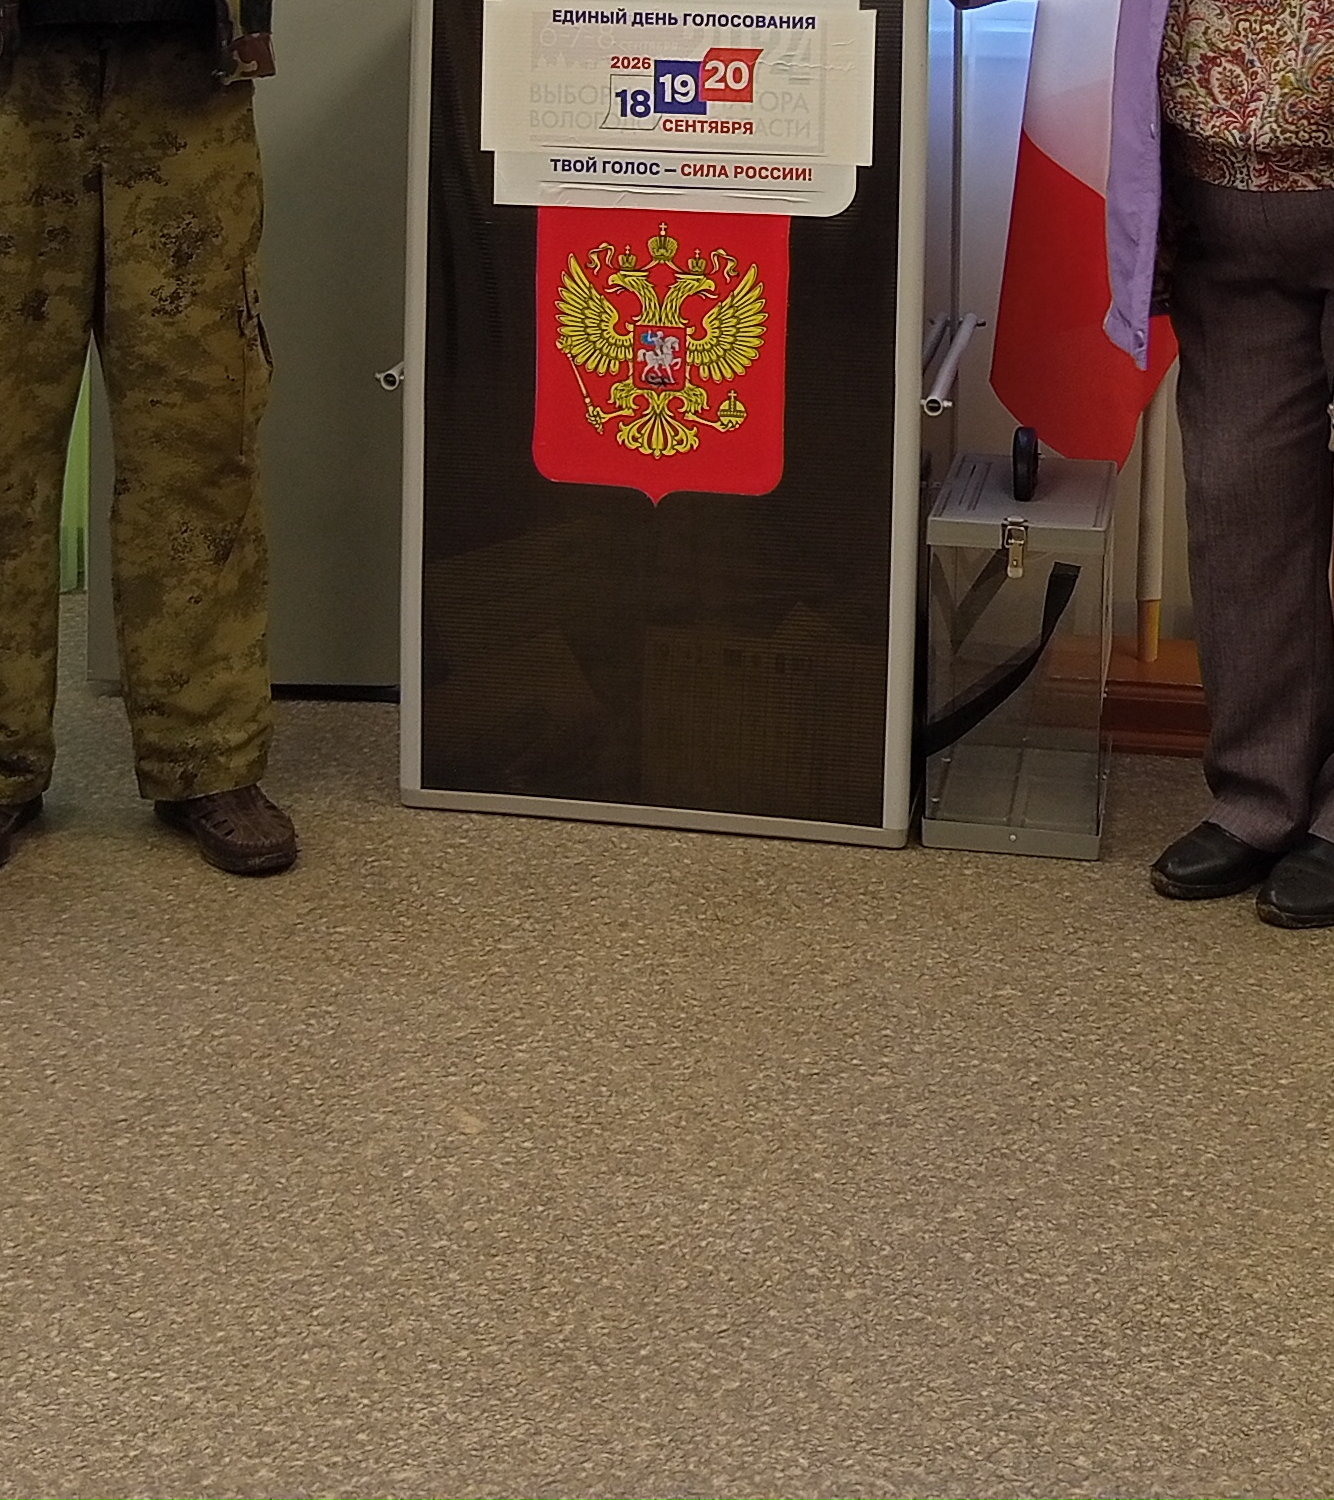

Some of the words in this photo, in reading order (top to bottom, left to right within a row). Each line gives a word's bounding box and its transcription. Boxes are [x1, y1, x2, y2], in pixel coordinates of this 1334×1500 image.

[552, 8, 627, 26] ЕДИНЫЙ
[631, 11, 678, 27] ДЕНЬ
[683, 13, 816, 29] ГОЛОСОВАНИЯ
[610, 56, 651, 69] 2026
[615, 89, 651, 118] 18
[659, 73, 696, 103] 19
[704, 60, 750, 90] 20
[662, 118, 754, 135] СЕНТЯБРЯ
[550, 156, 597, 173] ТВОЙ
[602, 160, 661, 176] ГОЛОС
[680, 163, 729, 179] СИЛА
[733, 165, 813, 182] РОССИИ!
